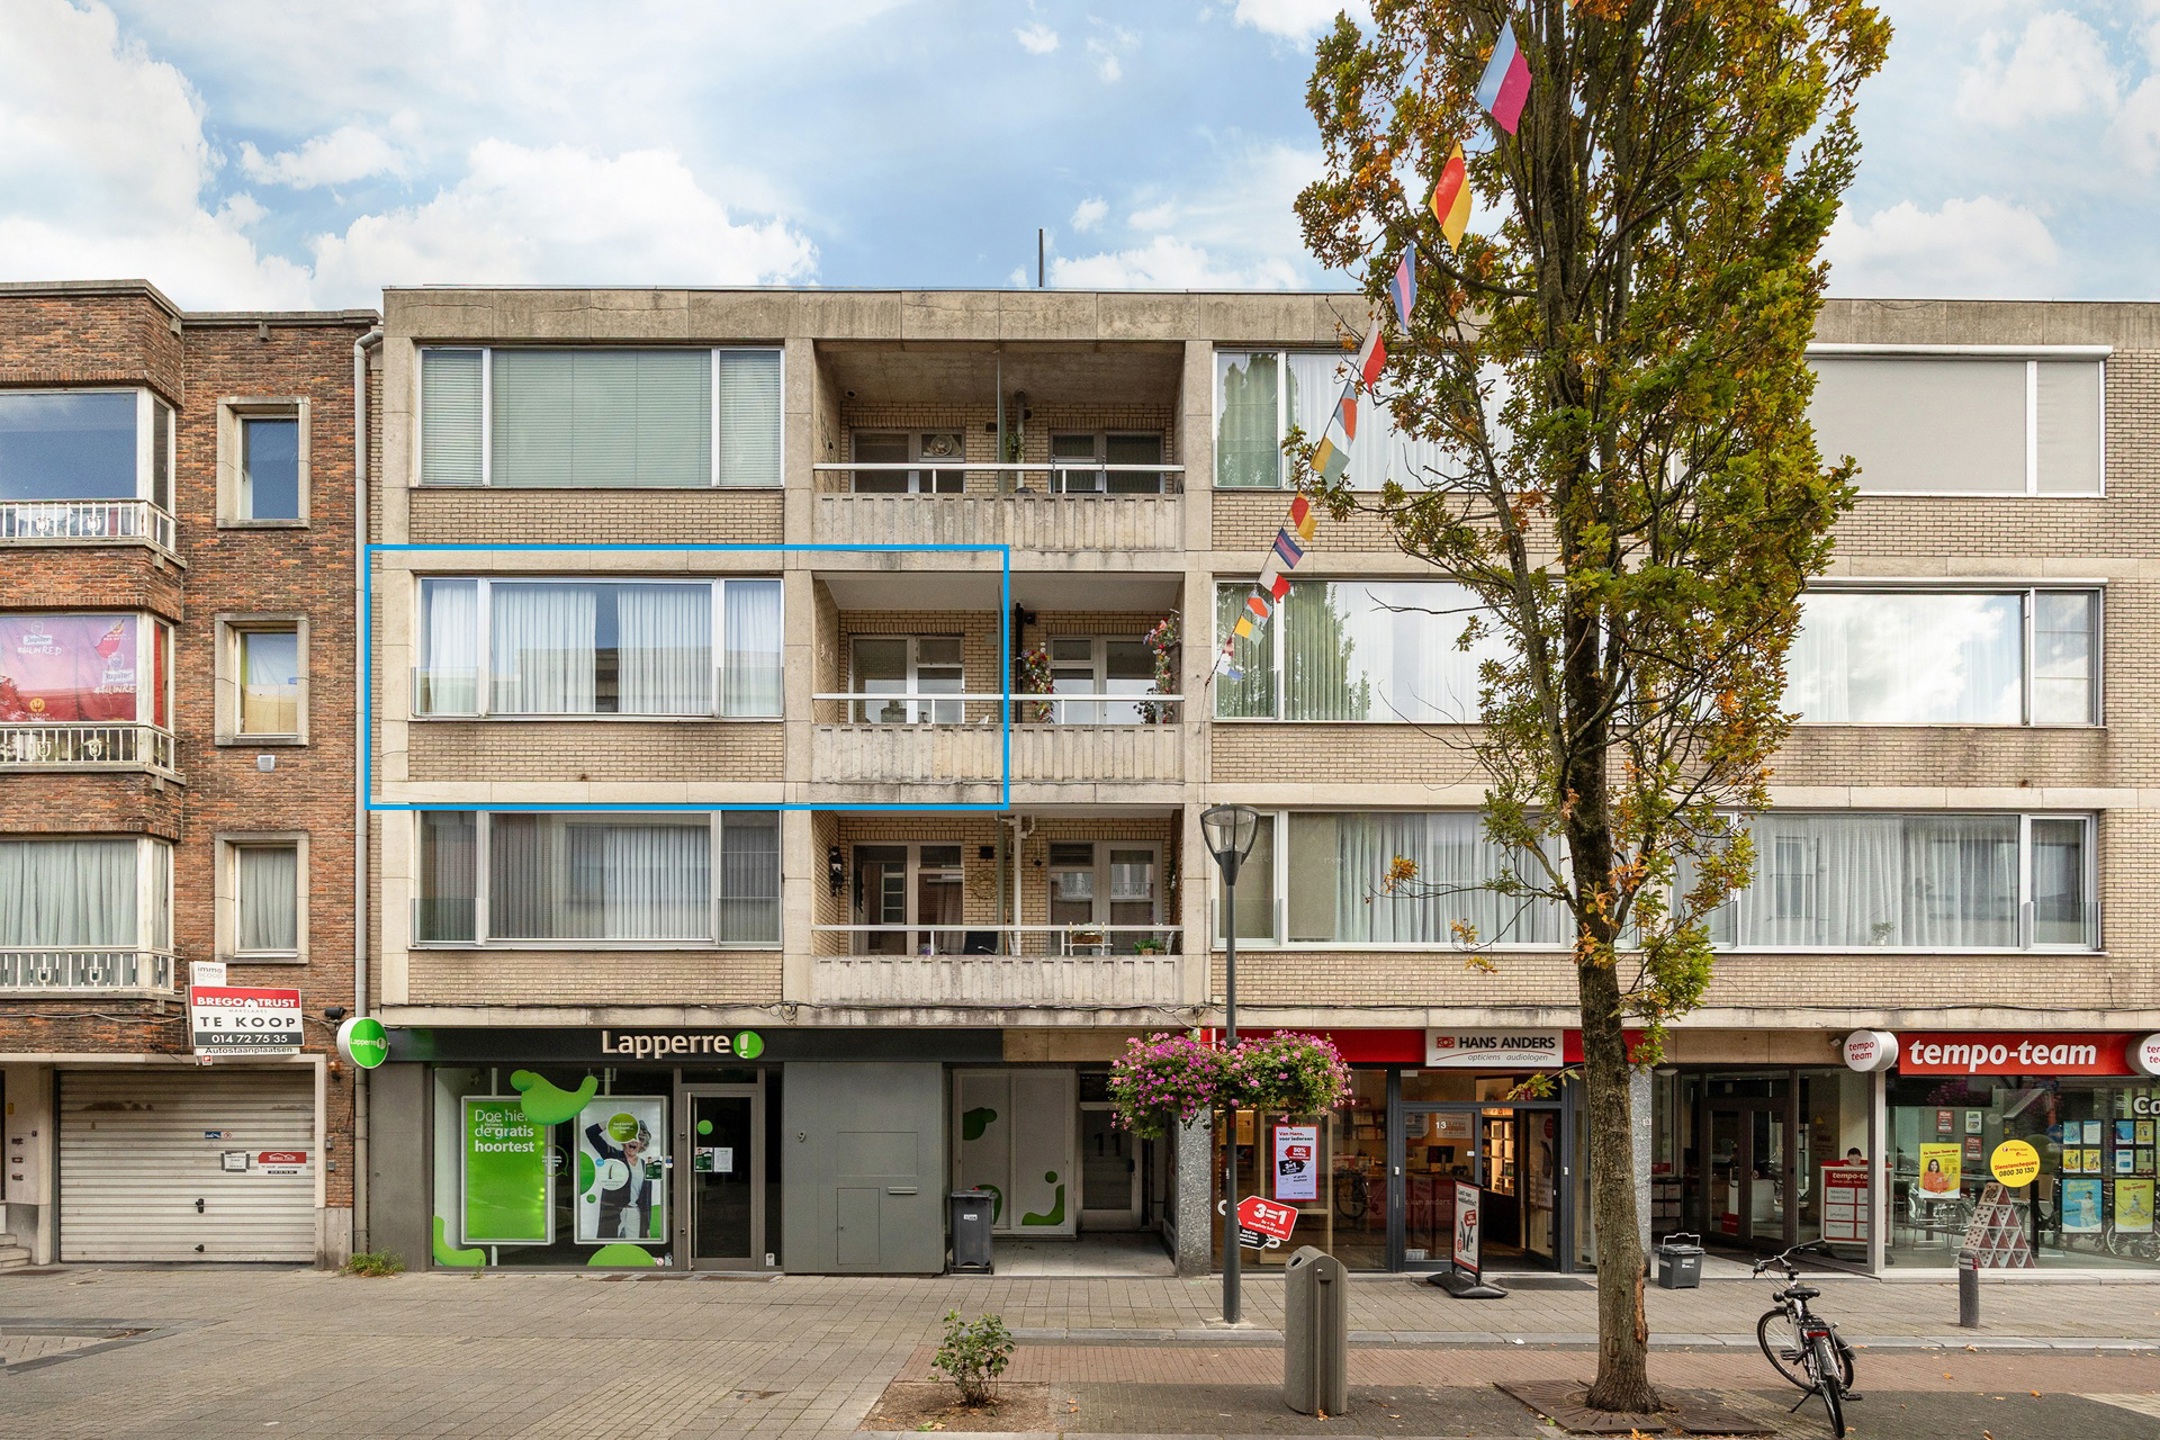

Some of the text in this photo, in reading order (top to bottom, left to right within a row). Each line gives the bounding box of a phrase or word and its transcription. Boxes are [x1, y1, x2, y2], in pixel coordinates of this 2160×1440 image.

[196, 996, 296, 1008] BREGO TRUST
[200, 1016, 296, 1028] TE KOOP
[211, 1034, 288, 1044] 014 72 75 35
[1458, 1036, 1557, 1050] HANS ANDERS
[205, 1046, 294, 1055] Autostaanplaatsen
[1848, 1041, 1875, 1051] tempo
[1467, 1053, 1549, 1063] opticiens audiologen
[1851, 1052, 1872, 1061] team
[1908, 1039, 2098, 1073] tempo-team
[475, 1109, 502, 1122] Doe
[1435, 1121, 1447, 1130] 13
[474, 1124, 492, 1137] de
[494, 1124, 534, 1139] gratis
[474, 1140, 535, 1152] hoortest
[1093, 1132, 1120, 1157] 11
[1994, 1161, 2038, 1171] Dienstencheques
[1832, 1172, 1868, 1181] tempo-te
[1999, 1169, 2014, 1177] 0800
[2015, 1168, 2024, 1176] 30
